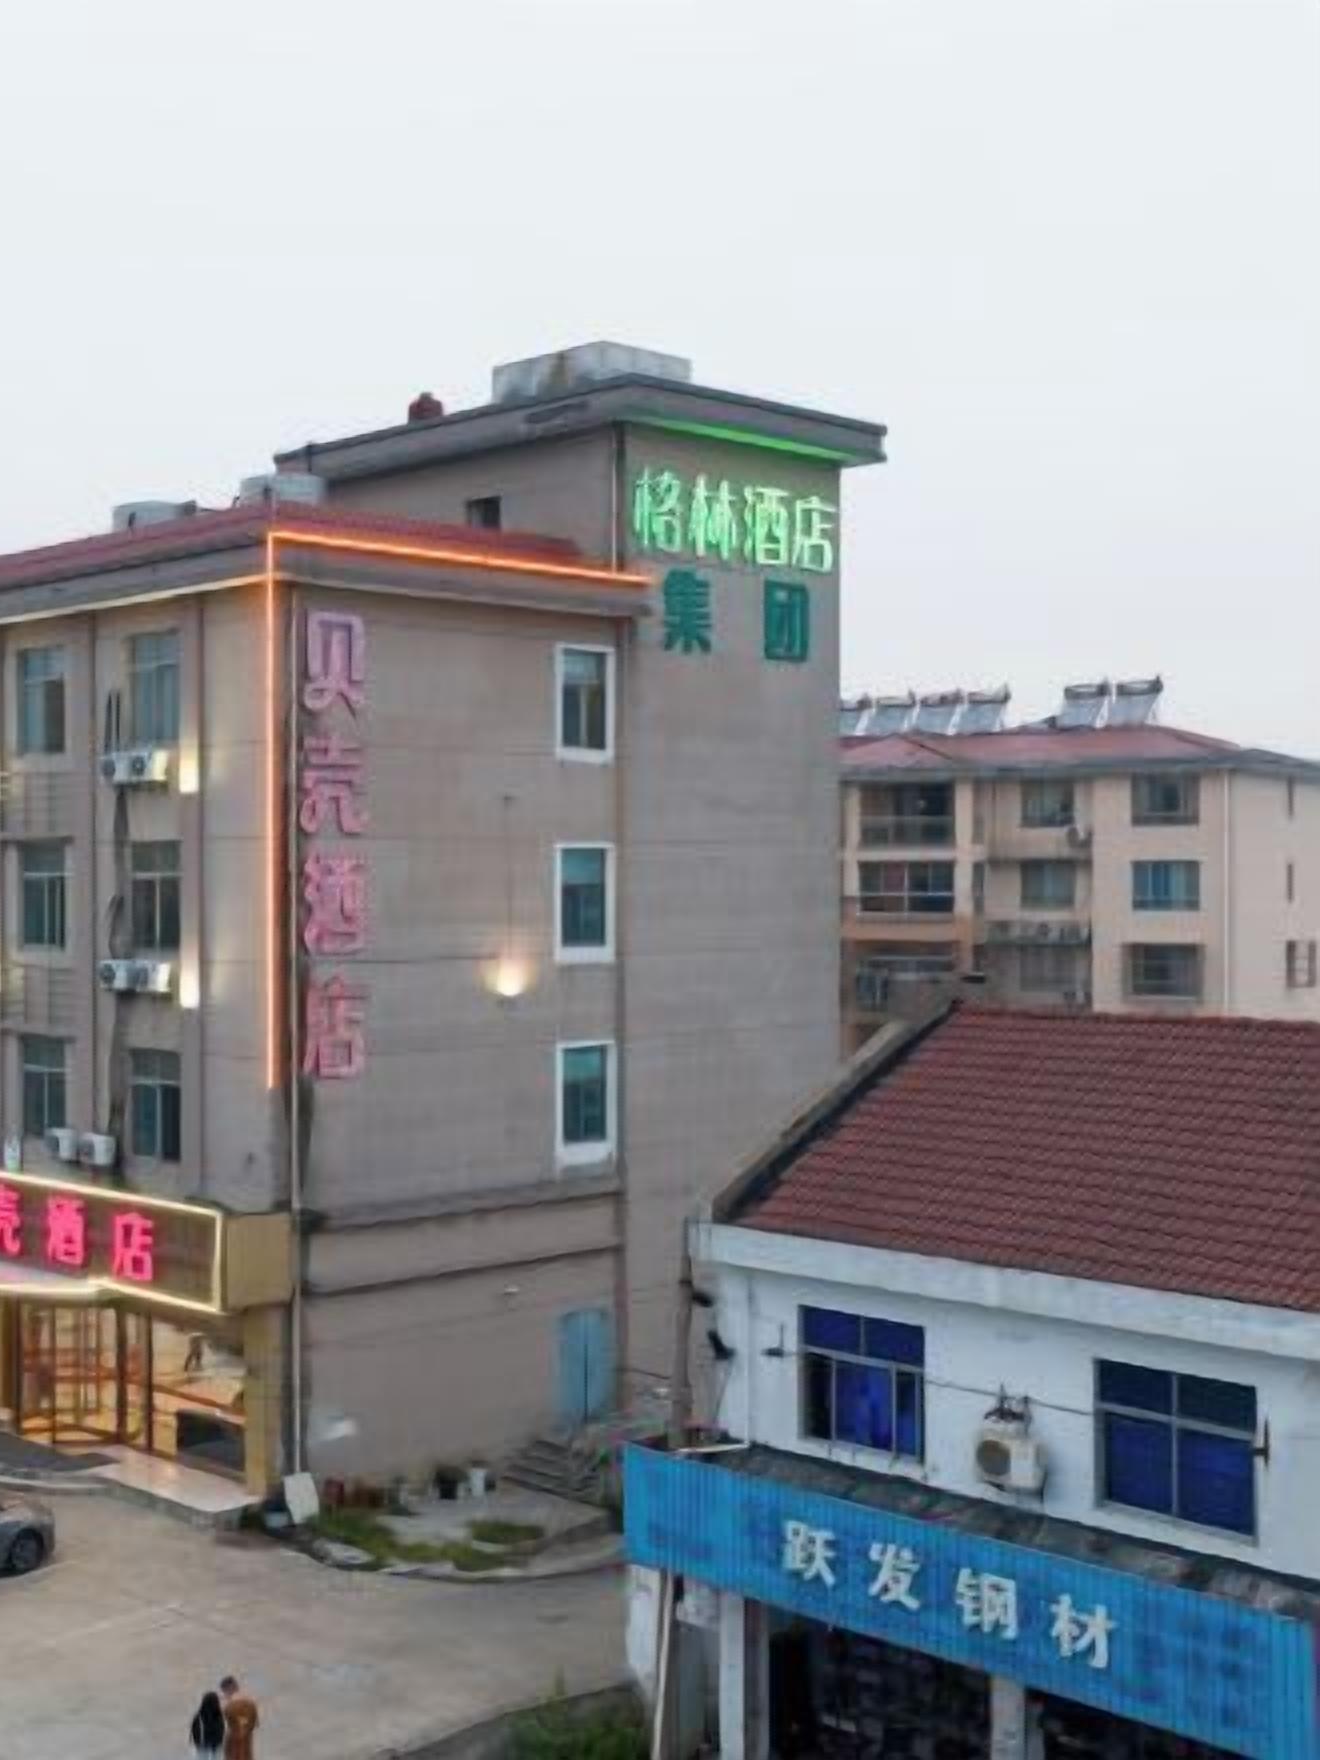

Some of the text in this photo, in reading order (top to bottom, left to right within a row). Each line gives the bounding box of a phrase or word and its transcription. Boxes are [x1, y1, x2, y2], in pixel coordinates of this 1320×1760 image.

[634, 465, 837, 573] 格林酒店
[663, 569, 810, 663] 集团
[299, 608, 370, 1080] 贝壳酒店
[783, 1520, 1118, 1669] 跃发钢材
